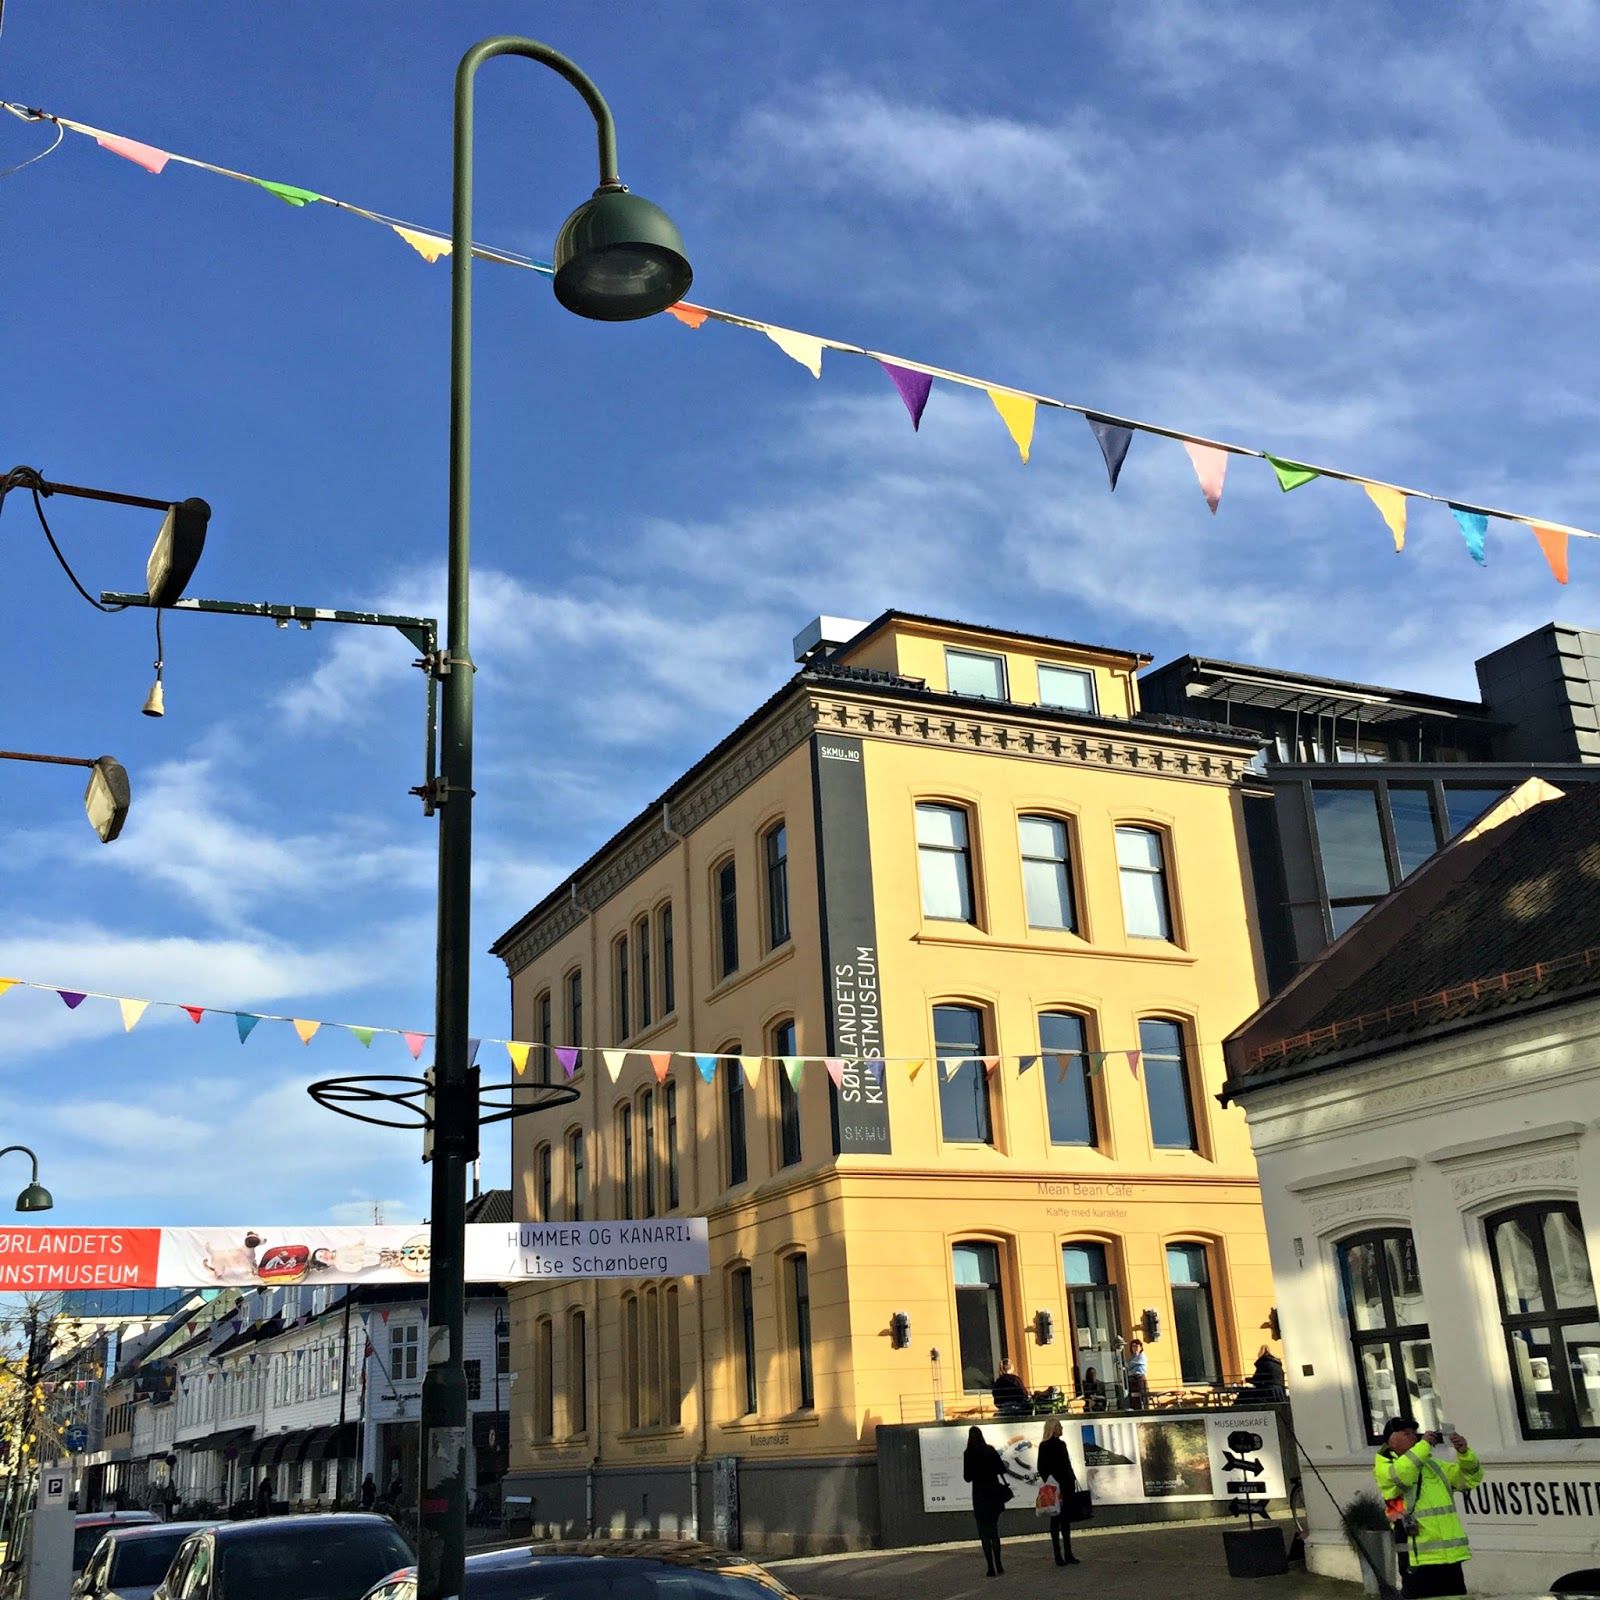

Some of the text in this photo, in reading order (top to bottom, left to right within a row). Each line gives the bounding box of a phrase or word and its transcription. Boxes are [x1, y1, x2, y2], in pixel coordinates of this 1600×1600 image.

[821, 746, 860, 760] SKMU.NO
[836, 964, 861, 1103] SØRLANDETS
[844, 1126, 886, 1141] SKMU
[1037, 1182, 1070, 1195] Mean
[1073, 1182, 1103, 1196] Bean
[1046, 1207, 1127, 1218] Kaffe med karakter
[507, 1225, 691, 1248] HUMMER OG KANARI!
[525, 1255, 564, 1274] Lise
[572, 1255, 668, 1273] Schønberg
